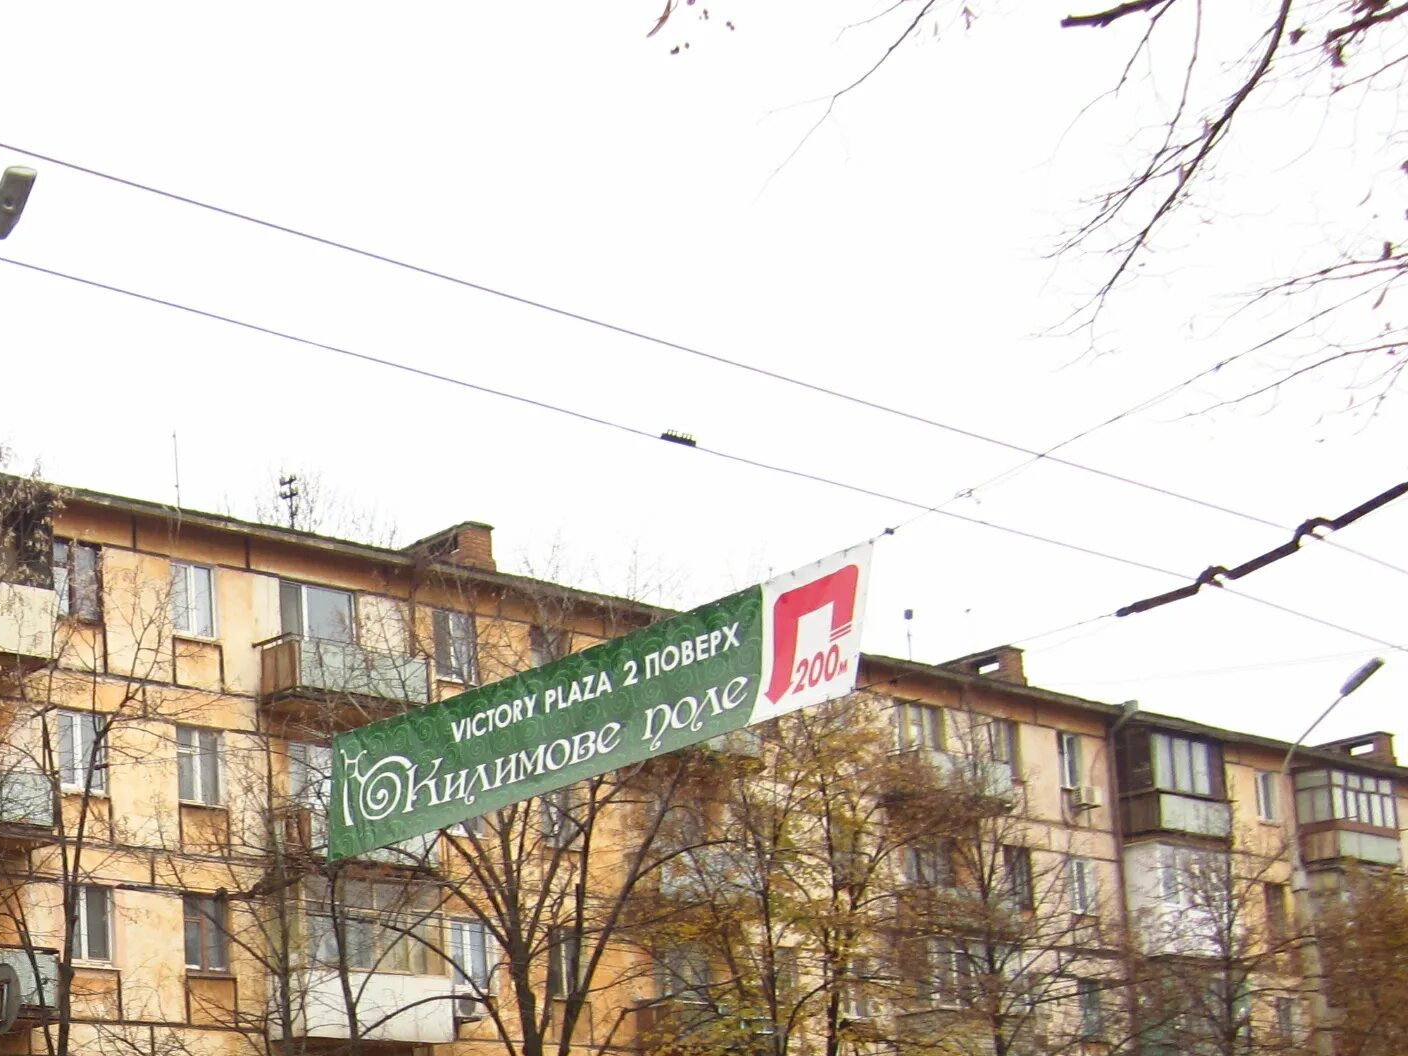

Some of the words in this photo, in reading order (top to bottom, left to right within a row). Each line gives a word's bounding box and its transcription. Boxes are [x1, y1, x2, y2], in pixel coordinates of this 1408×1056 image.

[451, 693, 539, 743] VICTORY
[544, 671, 612, 714] PLAZA
[622, 662, 639, 688] 2
[644, 622, 742, 679] ПОВЕРХ
